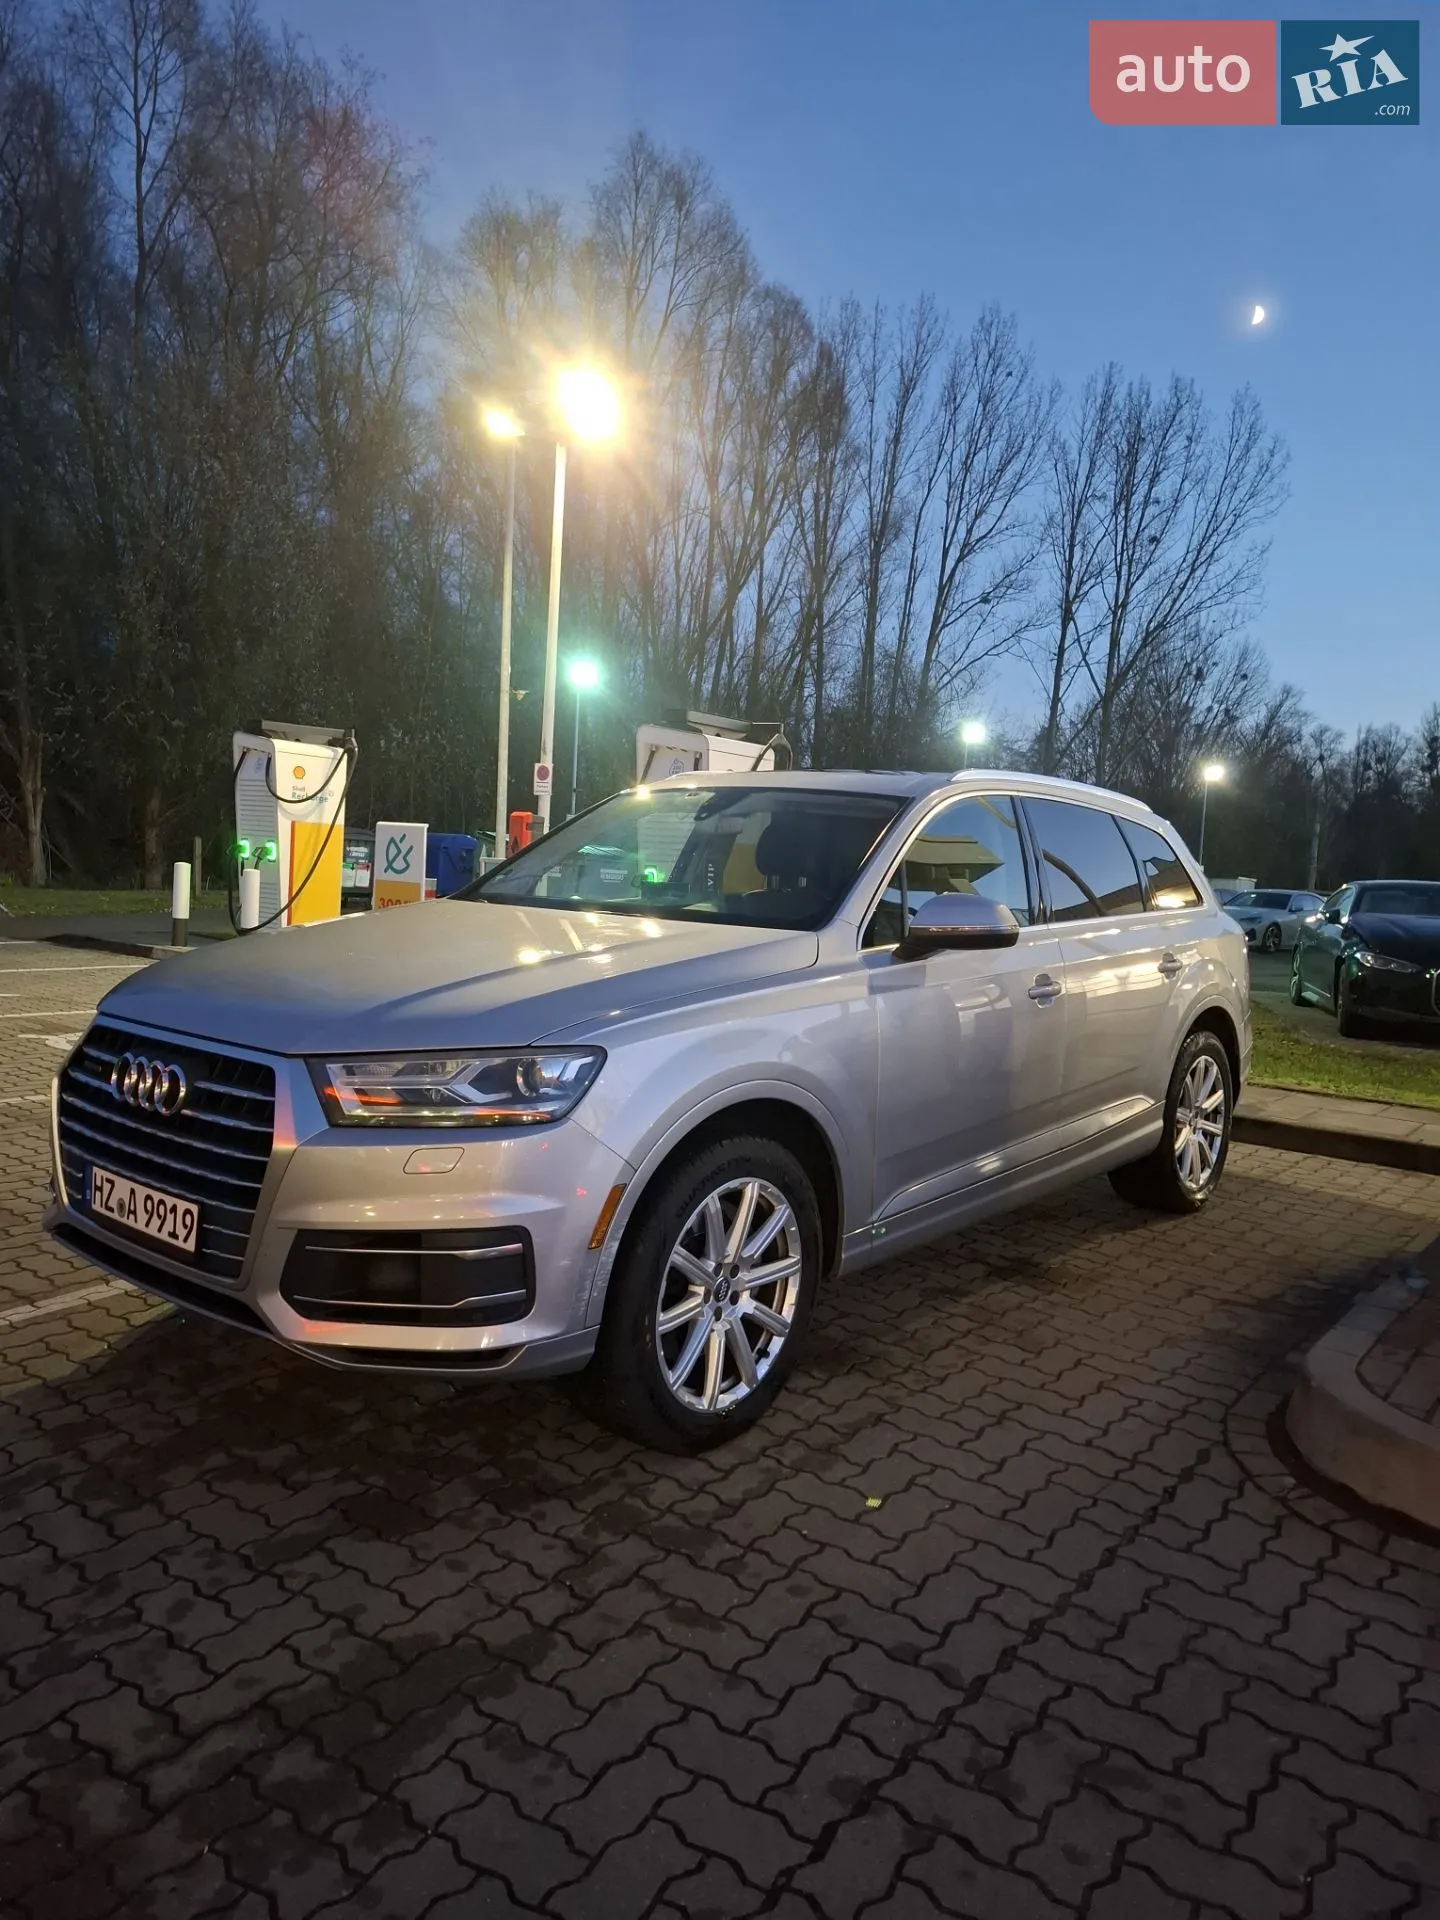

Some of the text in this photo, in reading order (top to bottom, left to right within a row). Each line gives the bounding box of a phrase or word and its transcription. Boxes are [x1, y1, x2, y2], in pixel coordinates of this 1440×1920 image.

[93, 1172, 195, 1244] HZ A 9919
